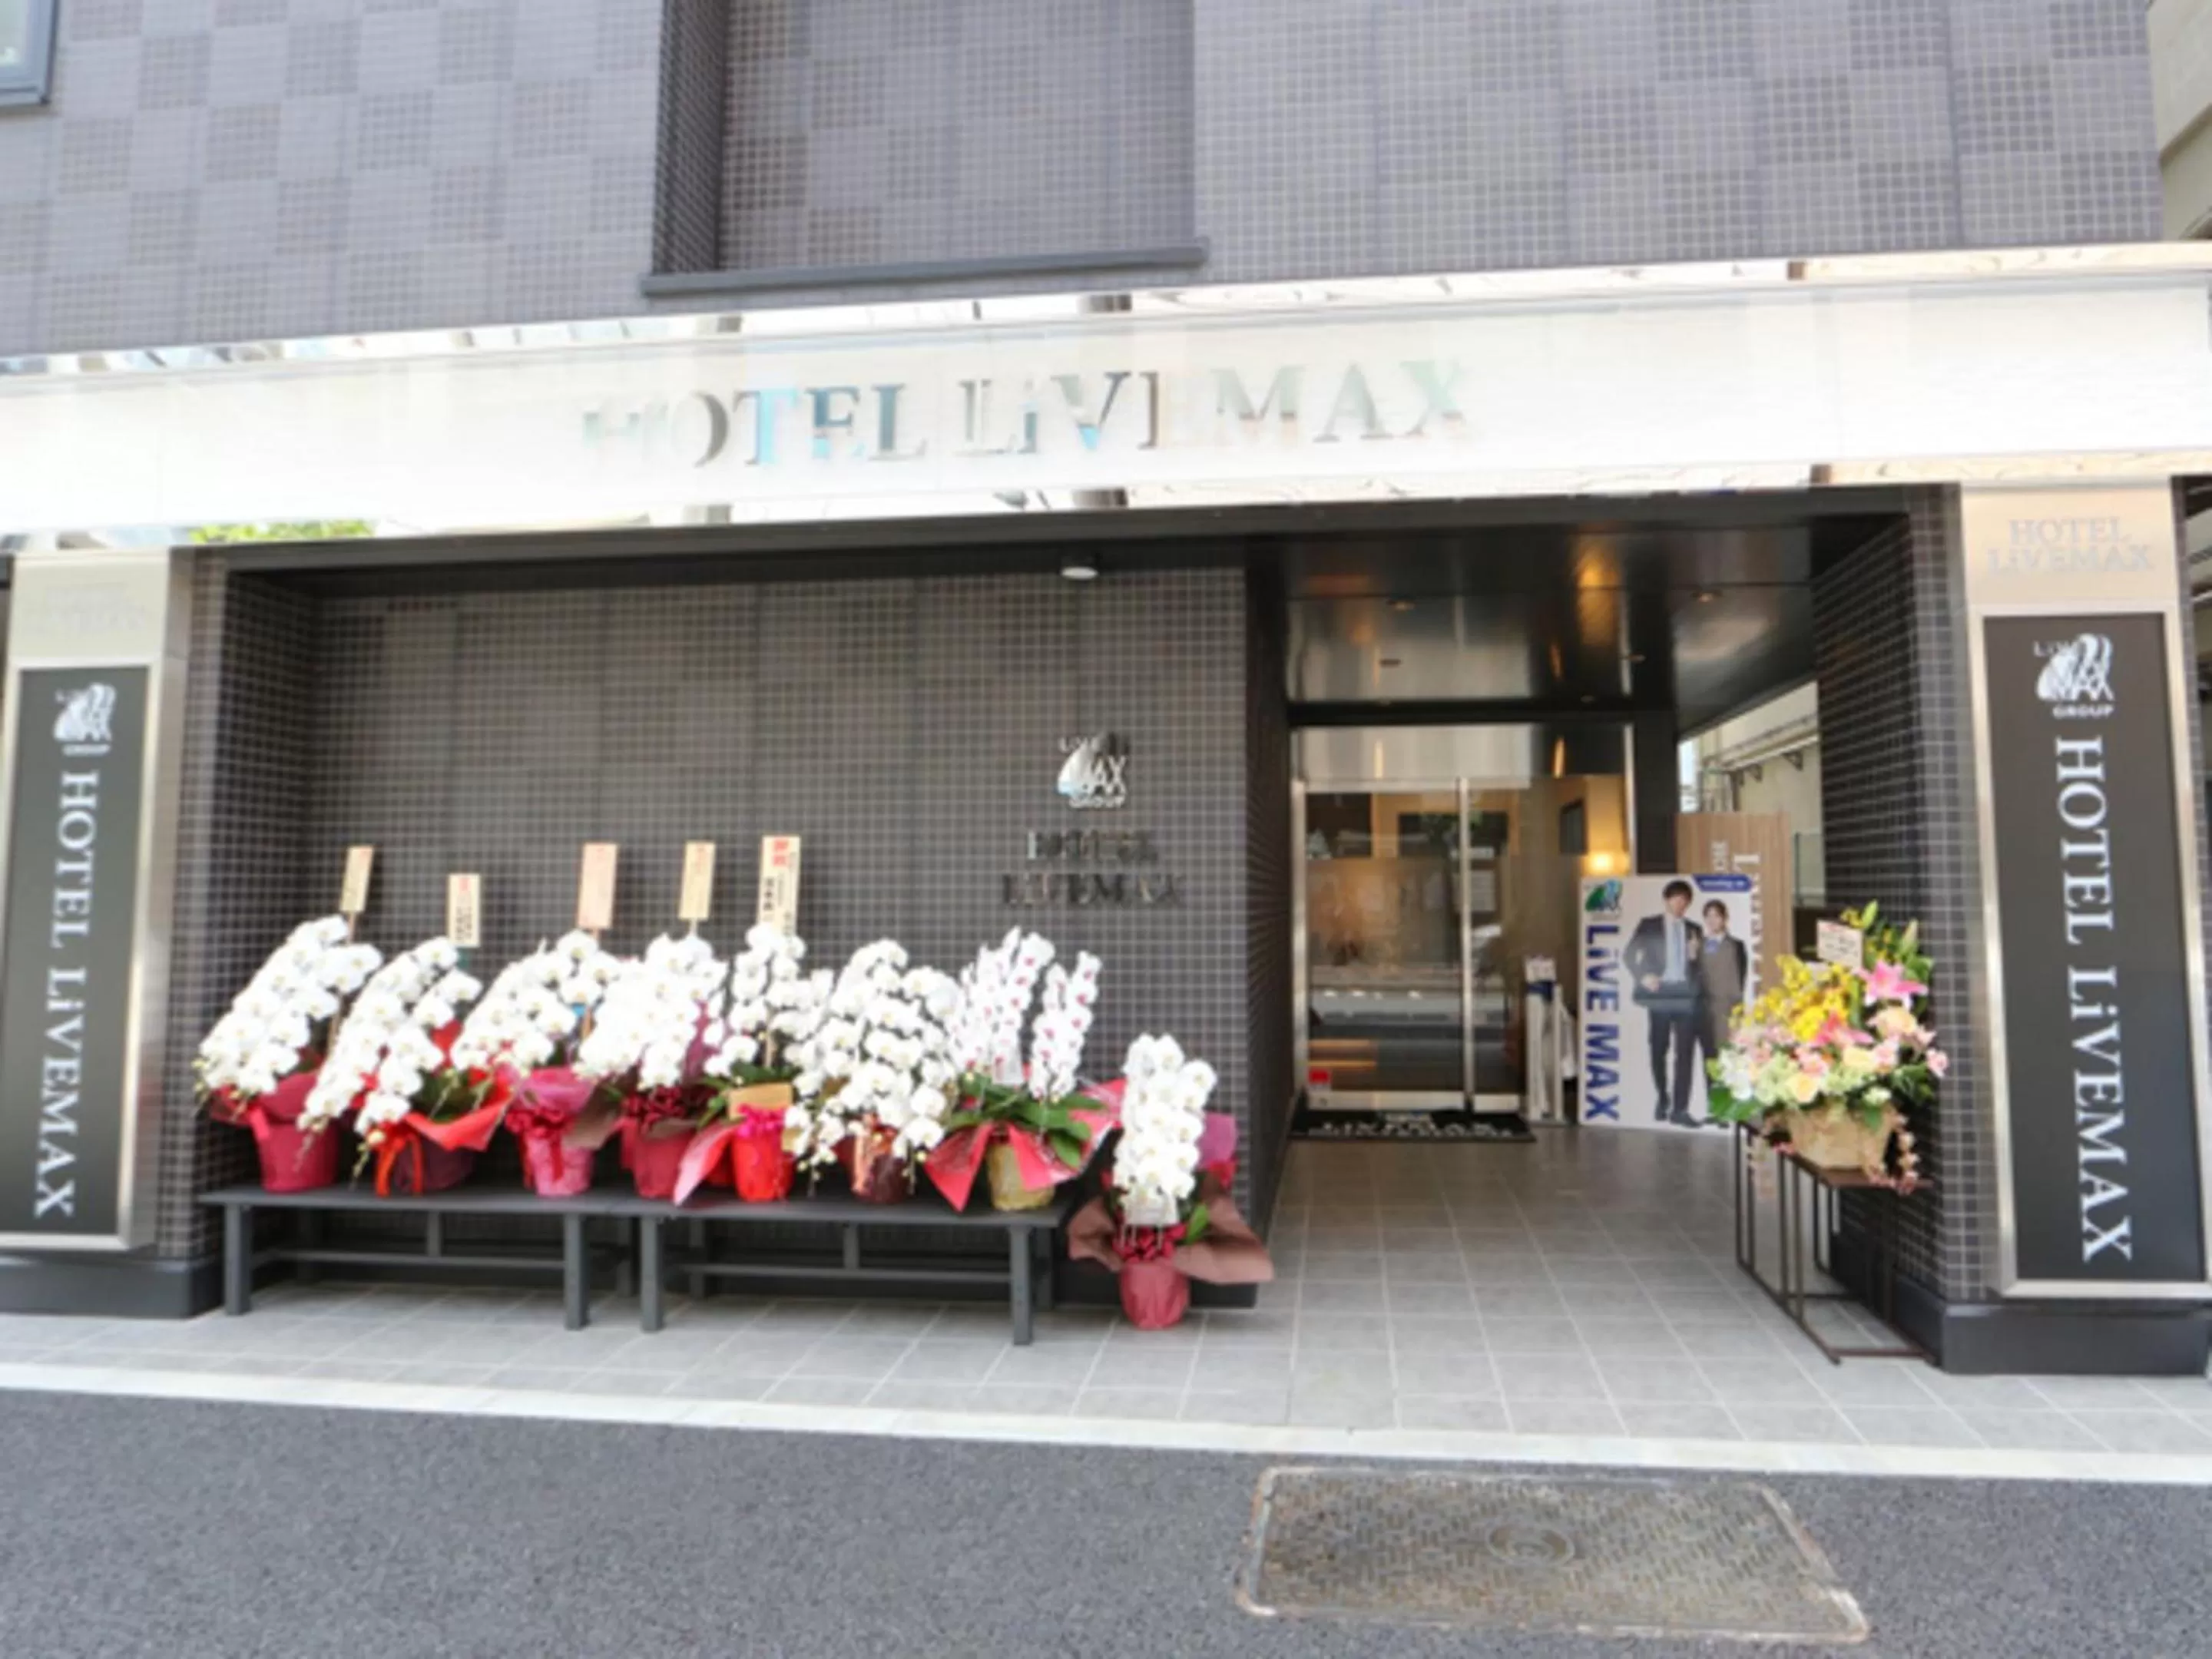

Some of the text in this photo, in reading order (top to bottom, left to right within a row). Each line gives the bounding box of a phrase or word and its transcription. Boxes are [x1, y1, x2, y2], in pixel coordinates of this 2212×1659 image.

[2008, 515, 2132, 546] HOTEL
[50, 770, 99, 949] HOTEL
[2055, 735, 2114, 945] HOTEL
